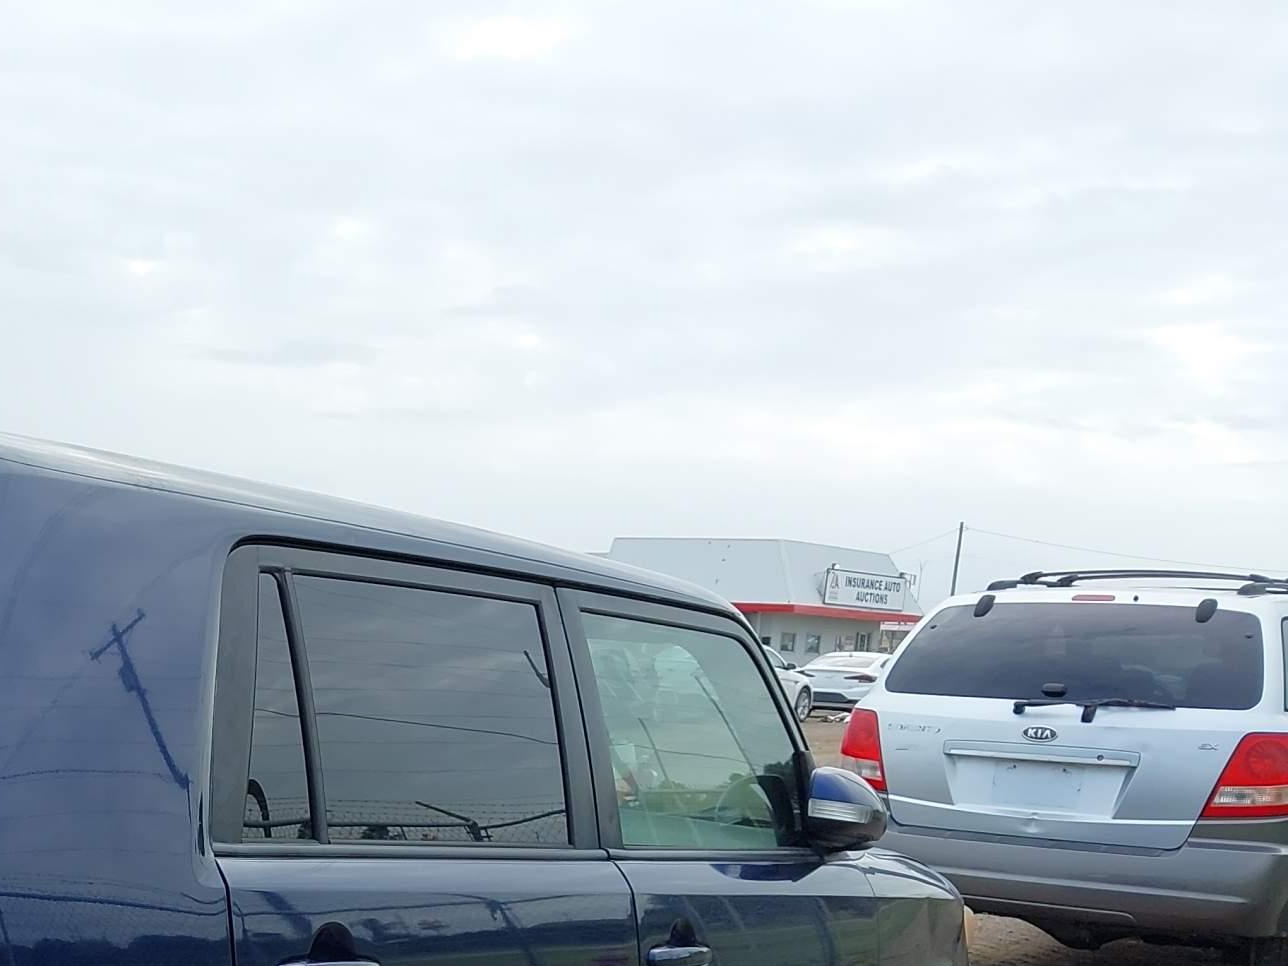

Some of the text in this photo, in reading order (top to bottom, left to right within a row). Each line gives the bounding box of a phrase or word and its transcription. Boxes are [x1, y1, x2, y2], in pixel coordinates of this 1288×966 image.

[845, 576, 883, 591] INSURANCE
[884, 581, 901, 592] AUTO
[856, 591, 888, 605] AUCTIONS
[1027, 728, 1052, 739] KIA
